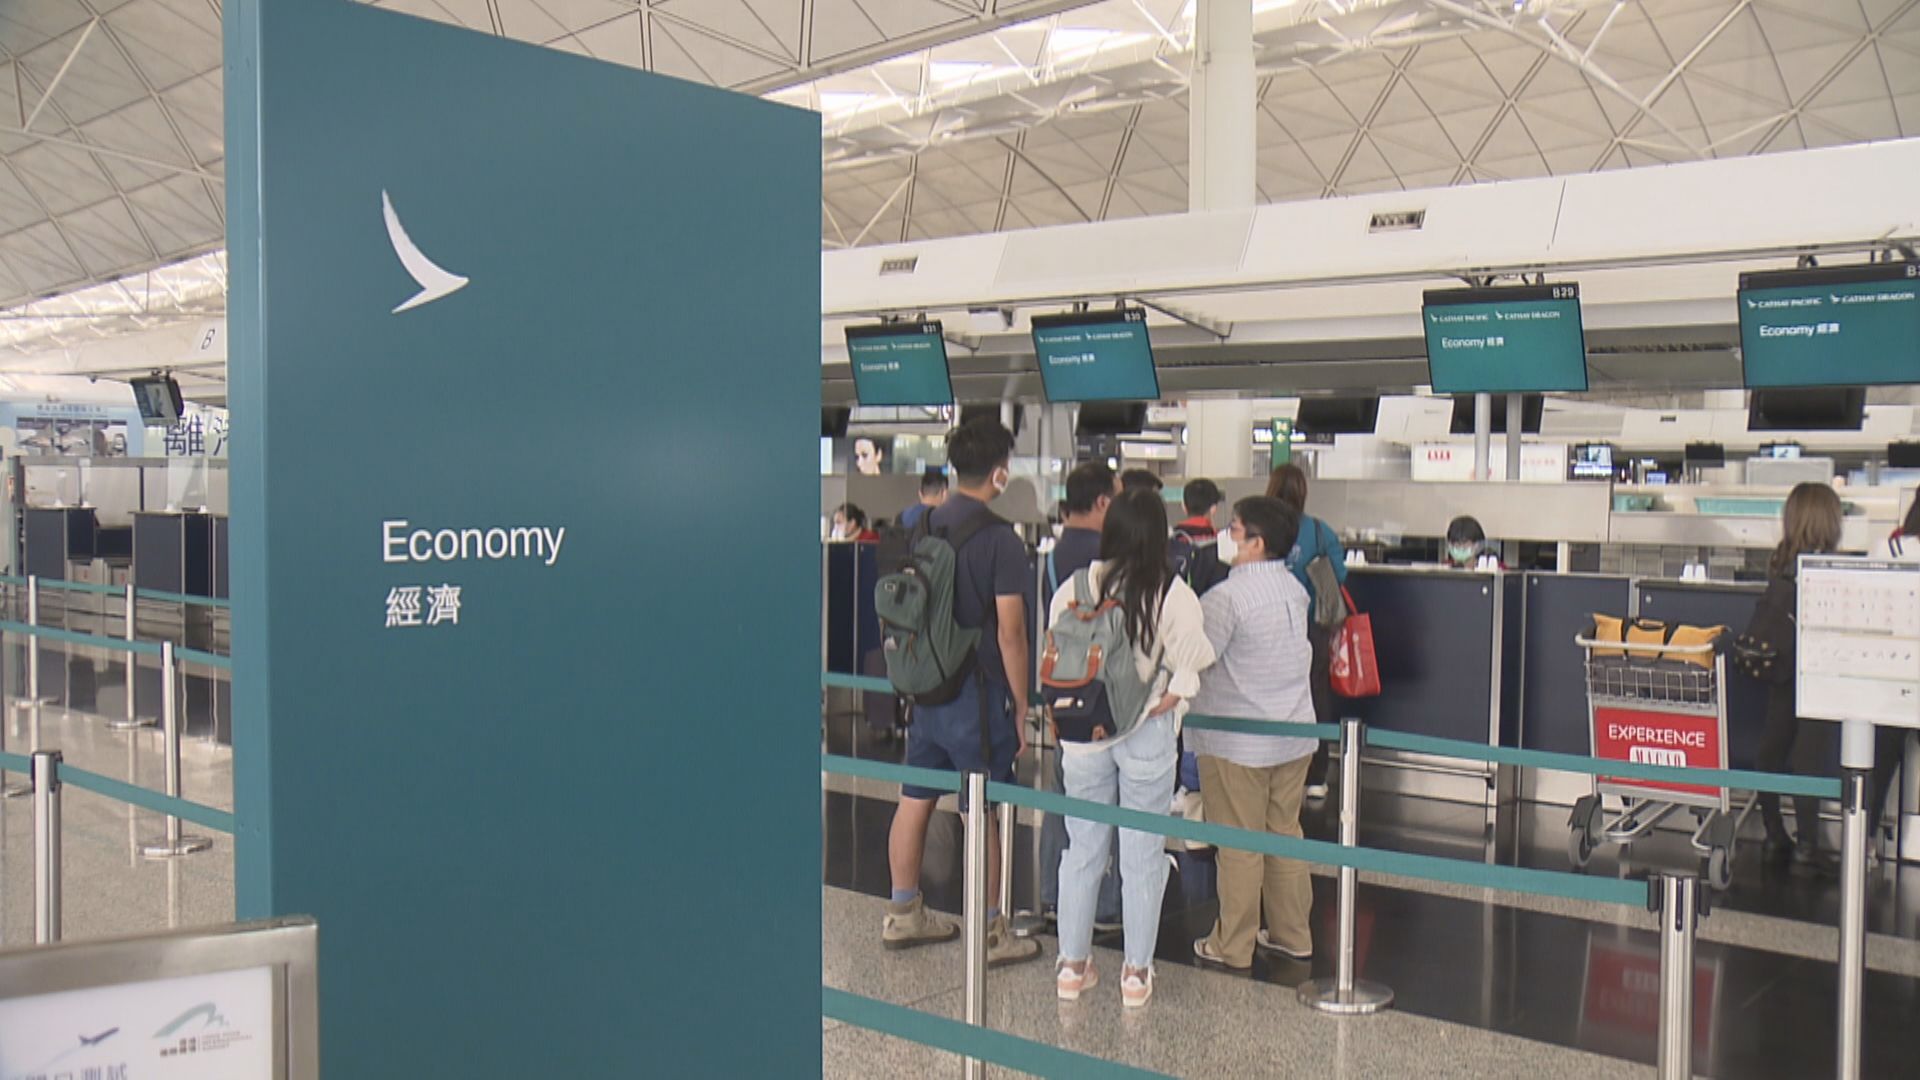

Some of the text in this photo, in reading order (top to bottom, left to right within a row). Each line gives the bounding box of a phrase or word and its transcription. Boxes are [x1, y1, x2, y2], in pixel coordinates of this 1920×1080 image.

[1552, 287, 1575, 298] B29
[201, 328, 215, 350] B
[1441, 336, 1486, 348] Economy
[1760, 325, 1815, 337] Economy
[383, 520, 565, 566] Economy
[385, 583, 462, 628] 經濟
[1608, 723, 1706, 748] EXPERIENCE
